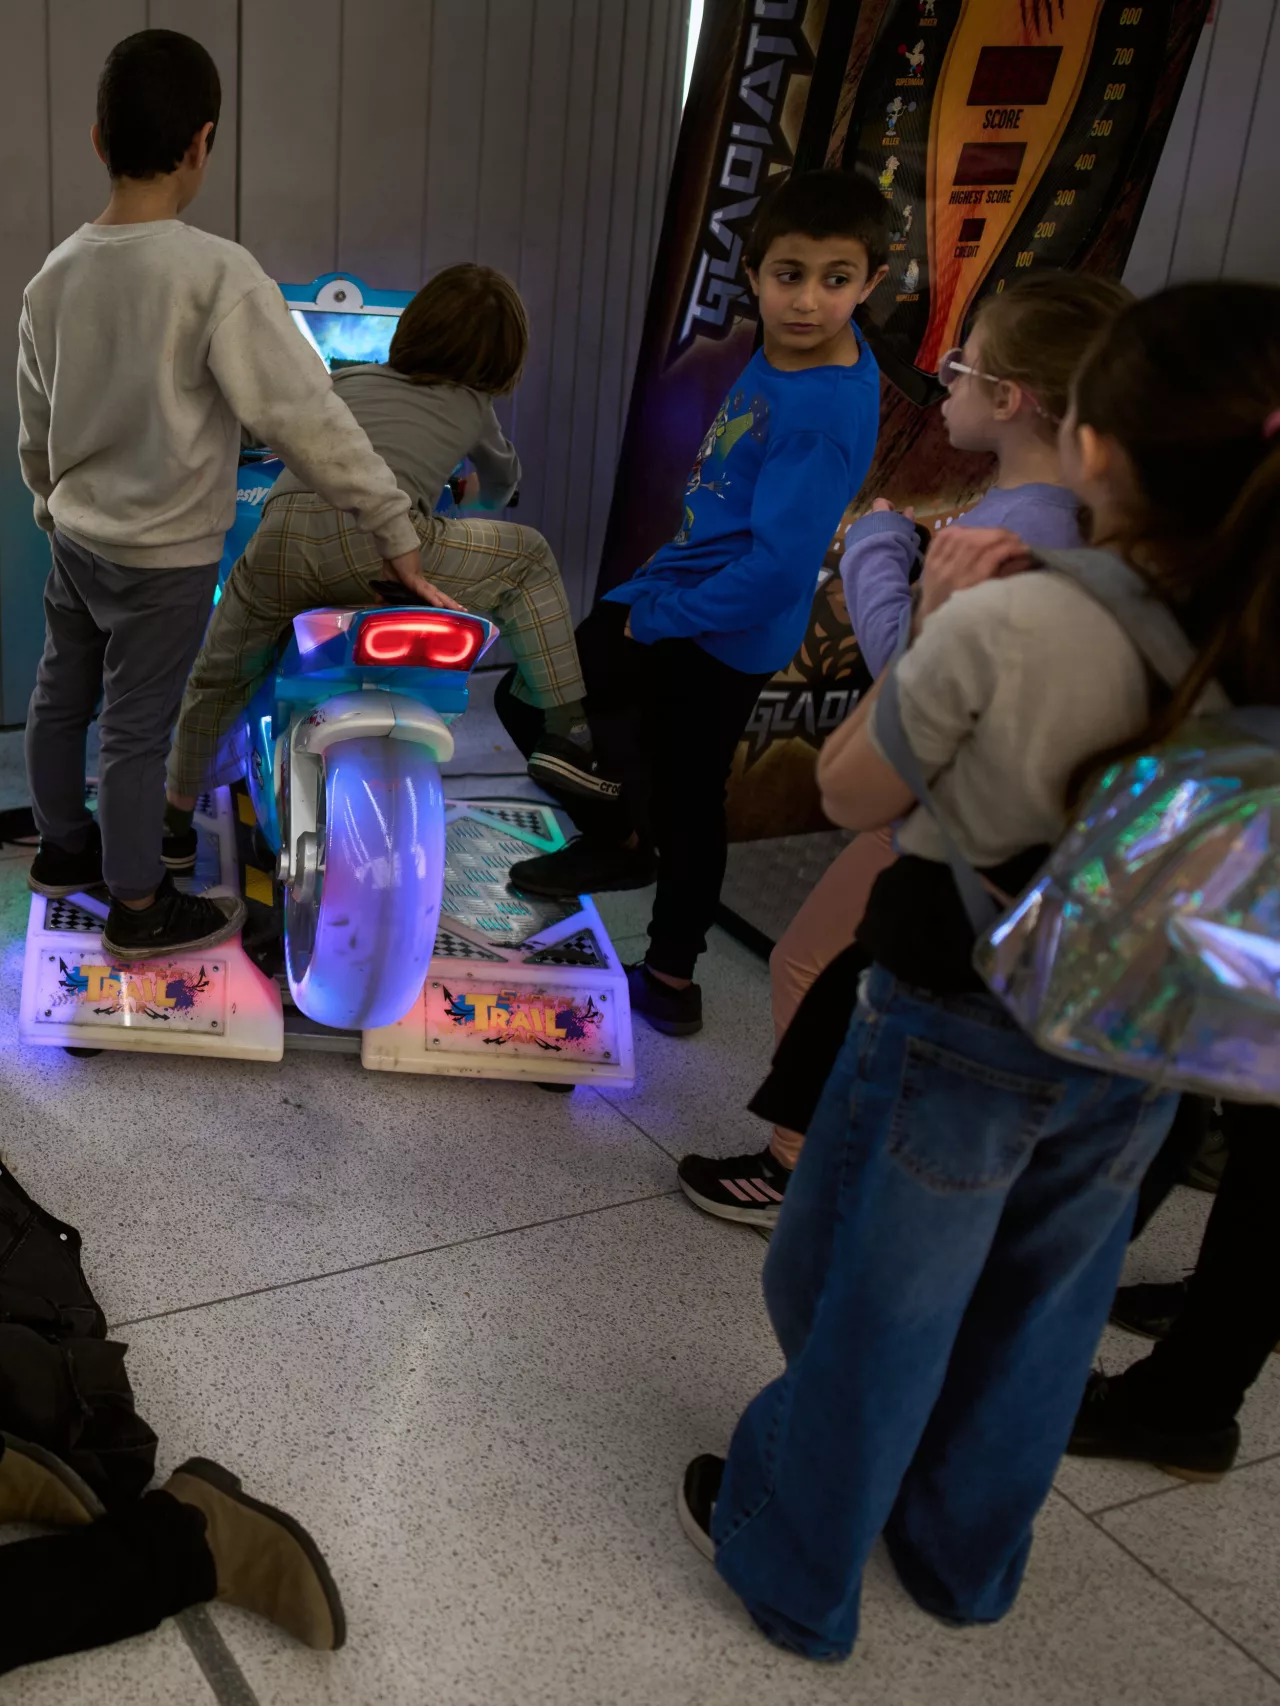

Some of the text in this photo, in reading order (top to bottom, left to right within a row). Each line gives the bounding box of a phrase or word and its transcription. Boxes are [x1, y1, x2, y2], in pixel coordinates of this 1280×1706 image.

[1119, 7, 1143, 26] 800
[1112, 48, 1135, 66] 700
[1103, 83, 1126, 100] 600
[982, 109, 1024, 129] SCORE
[1090, 119, 1113, 137] 500
[1074, 153, 1096, 171] 400
[948, 189, 1014, 205] HIGHEST SCORE
[1053, 189, 1076, 206] 300
[1034, 222, 1056, 239] 200
[954, 245, 980, 258] CREDIT
[1015, 251, 1035, 268] 100
[996, 279, 1005, 294] 0
[79, 964, 180, 1008] TRAIL
[464, 993, 568, 1038] TRAIL
